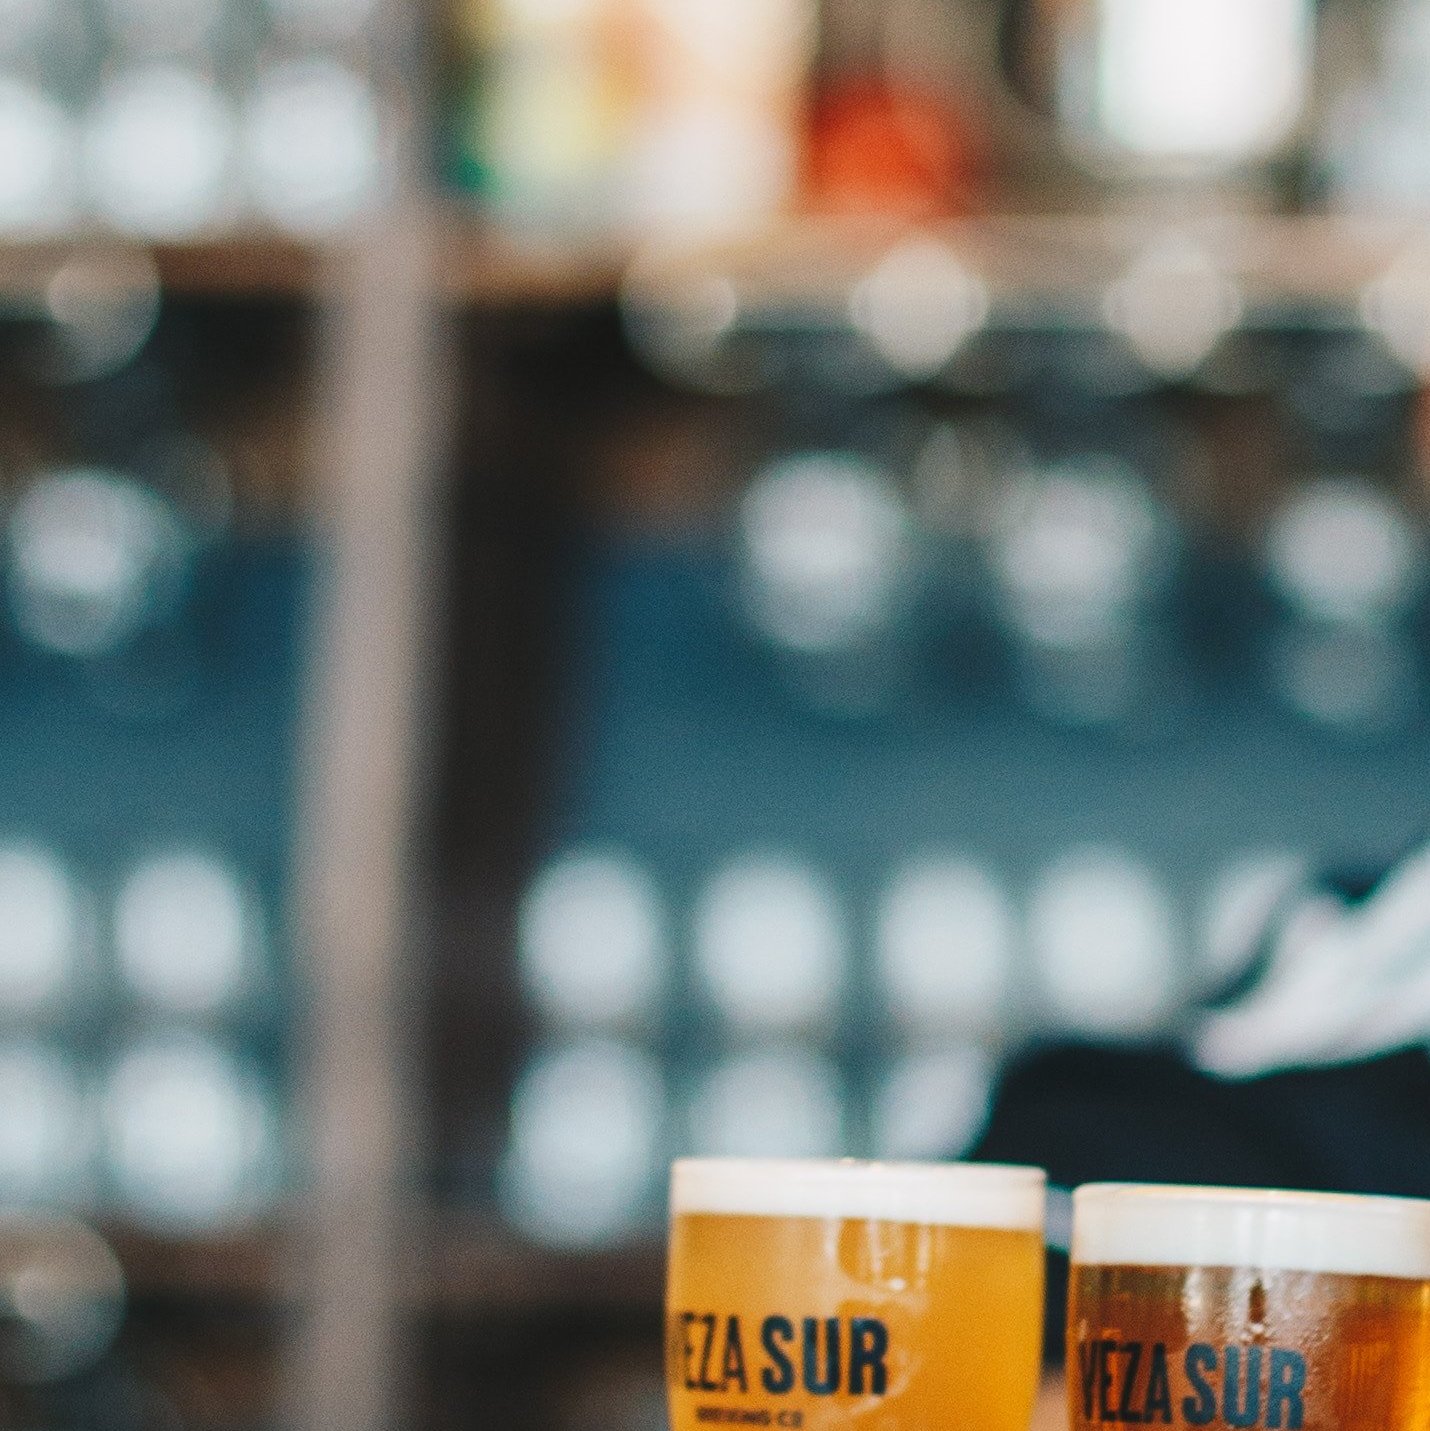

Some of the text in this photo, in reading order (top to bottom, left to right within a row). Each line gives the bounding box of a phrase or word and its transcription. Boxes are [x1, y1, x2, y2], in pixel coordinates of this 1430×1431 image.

[760, 1314, 888, 1396] SUR
[1077, 1339, 1308, 1431] VEZA SUR
